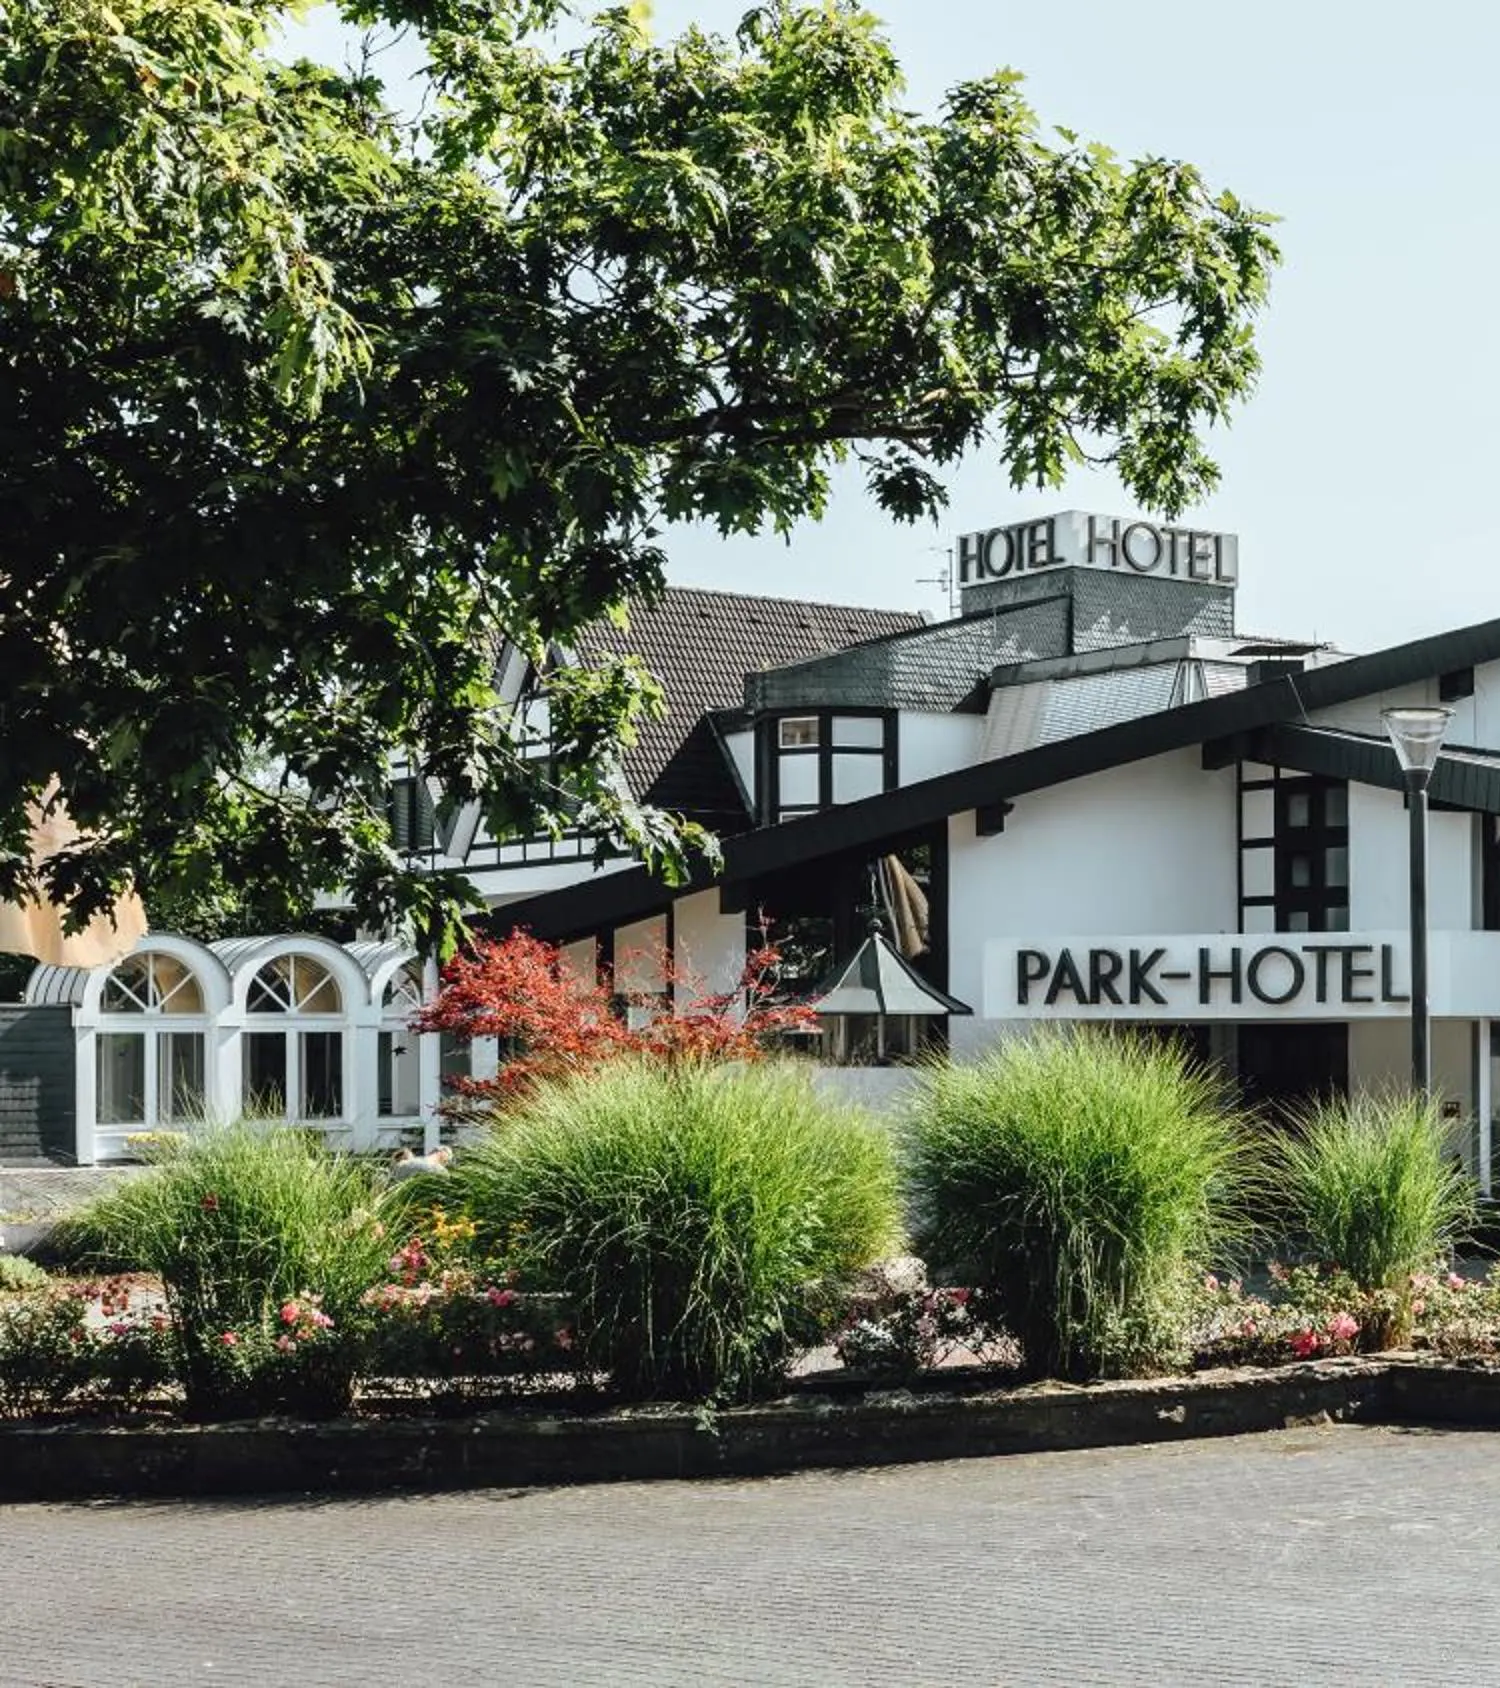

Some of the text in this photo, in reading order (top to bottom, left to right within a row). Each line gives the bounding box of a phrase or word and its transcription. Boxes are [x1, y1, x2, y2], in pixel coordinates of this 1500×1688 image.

[959, 517, 1065, 583] HOTEL
[1087, 515, 1235, 582] HOTEL
[1016, 944, 1411, 1005] PARK-HOTEL
